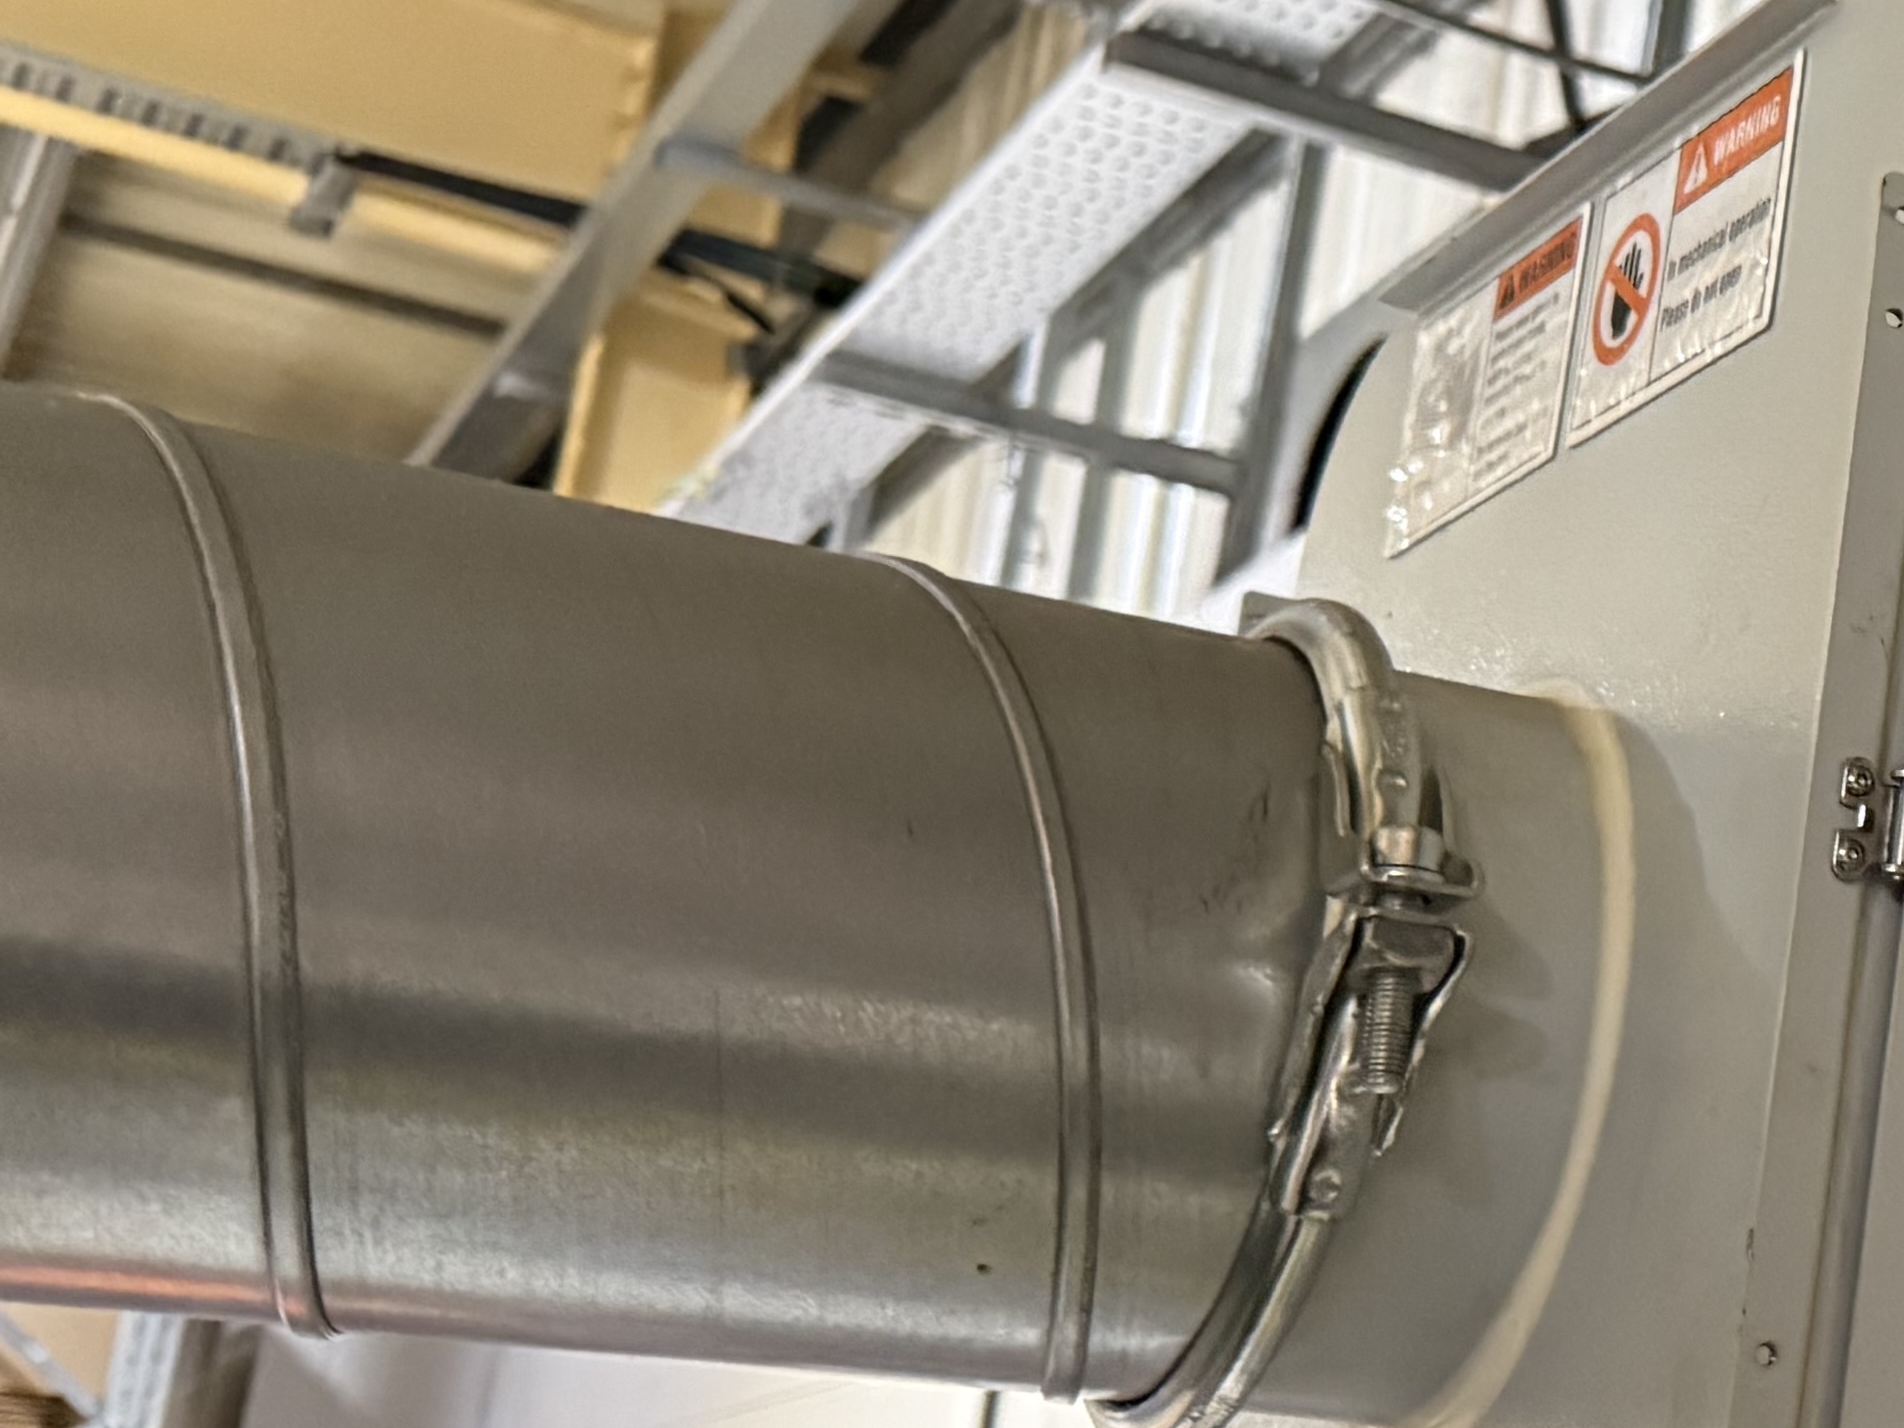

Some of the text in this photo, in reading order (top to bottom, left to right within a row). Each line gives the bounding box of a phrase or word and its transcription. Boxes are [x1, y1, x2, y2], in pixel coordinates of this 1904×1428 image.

[1712, 94, 1781, 168] WARNING
[1678, 222, 1728, 275] mechanical
[1729, 197, 1771, 242] operation
[1660, 300, 1689, 332] Please
[1690, 288, 1701, 313] do
